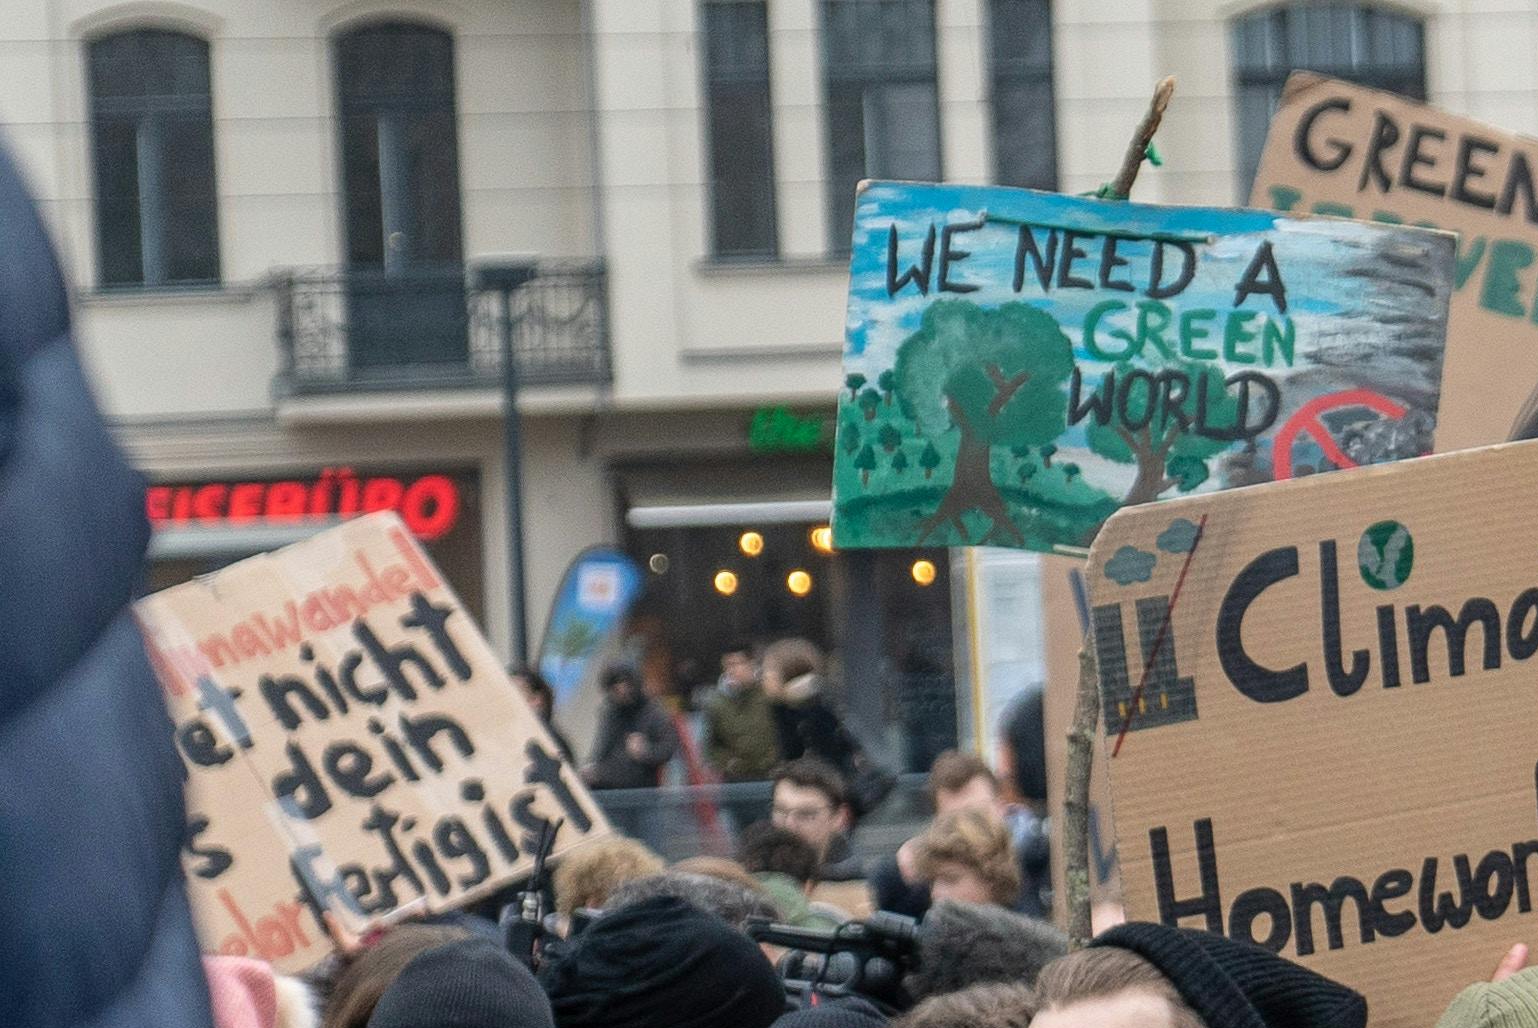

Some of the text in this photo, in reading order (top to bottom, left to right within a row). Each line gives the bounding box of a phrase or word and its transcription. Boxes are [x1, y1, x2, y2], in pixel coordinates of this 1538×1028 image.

[886, 217, 987, 299] WE
[1011, 223, 1196, 299] NEED
[1233, 239, 1288, 313] A
[1082, 301, 1296, 368] GREEN
[1067, 368, 1282, 440] WORLD
[257, 590, 473, 731] nicht
[271, 710, 475, 821] dein
